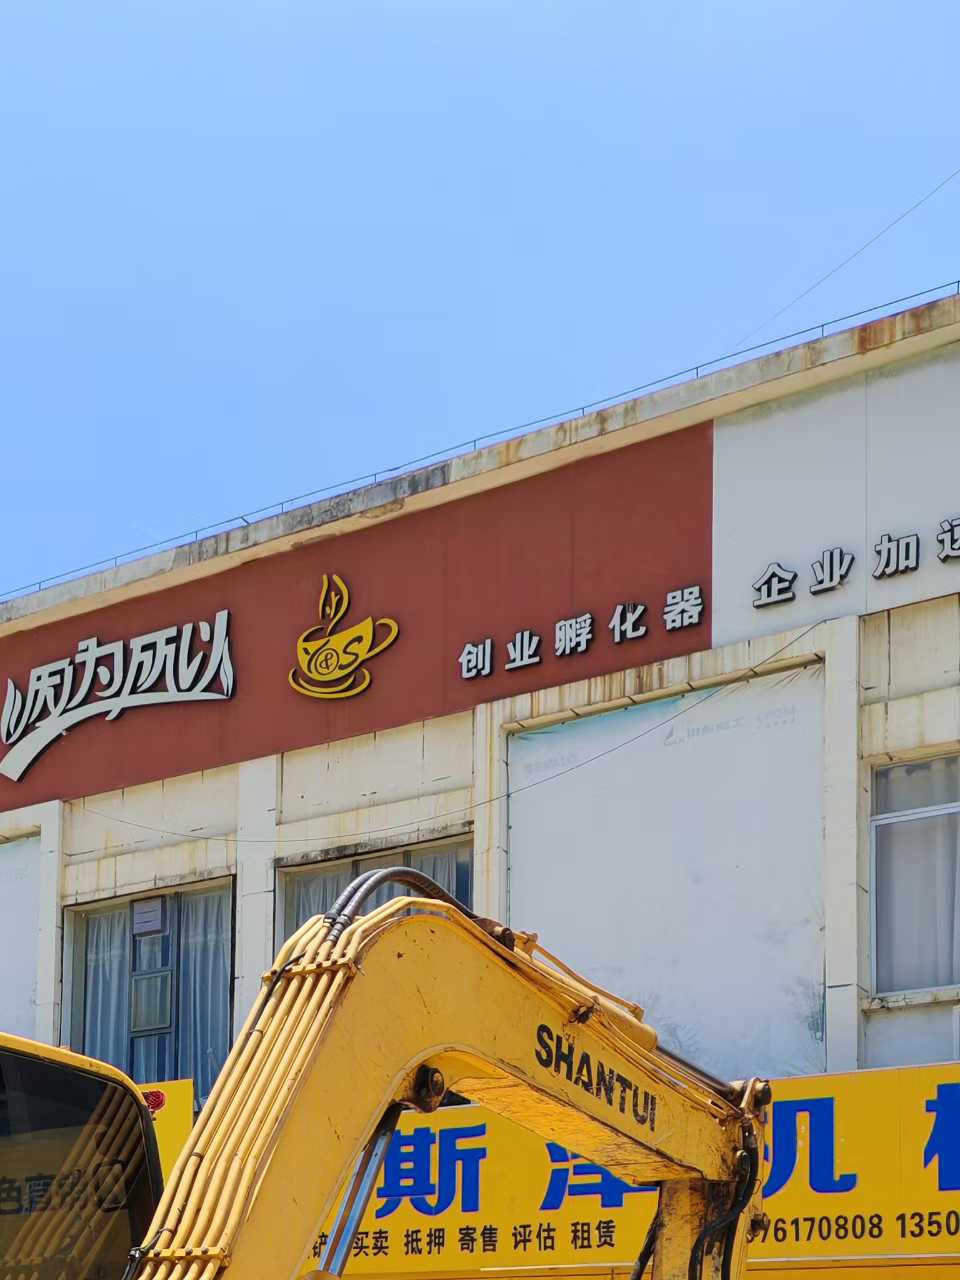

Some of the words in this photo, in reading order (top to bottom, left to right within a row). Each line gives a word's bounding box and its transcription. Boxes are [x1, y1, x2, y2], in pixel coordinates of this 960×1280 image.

[458, 585, 704, 680] 创业孵化器
[534, 1023, 657, 1132] SHANTUI
[352, 1228, 390, 1258] 买卖
[404, 1227, 445, 1255] 抵押
[458, 1224, 499, 1253] 寄售
[512, 1223, 556, 1252] 评估
[571, 1219, 617, 1249] 租赁
